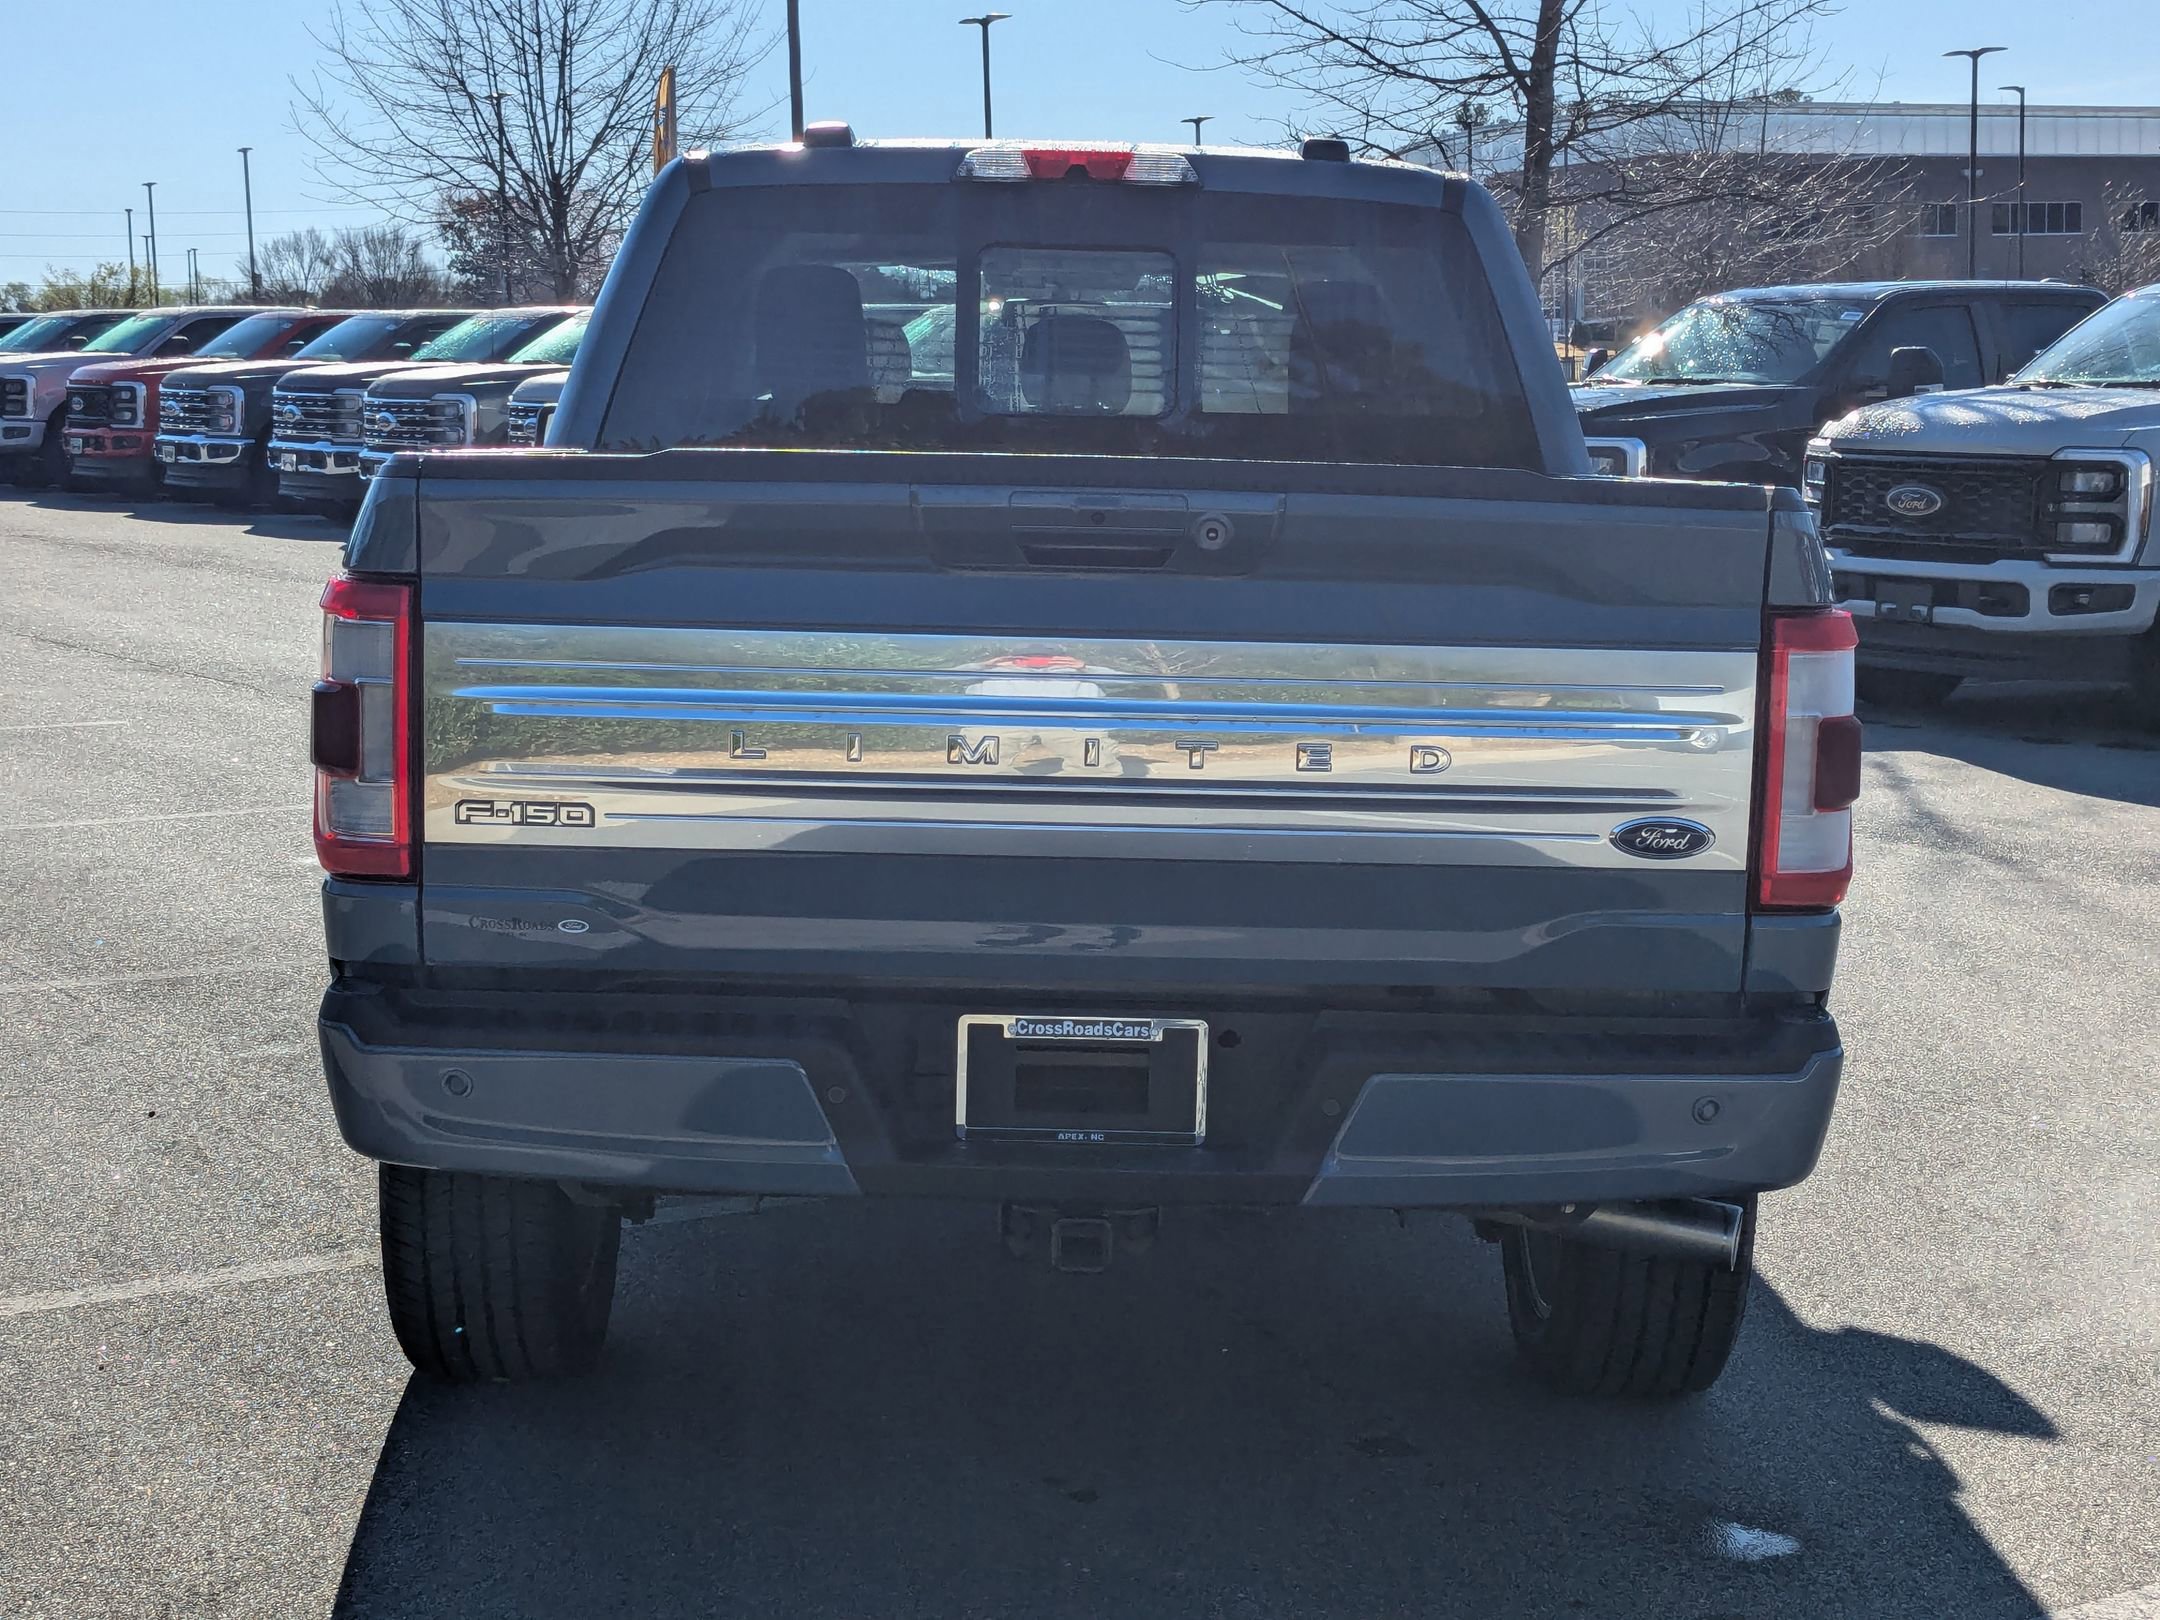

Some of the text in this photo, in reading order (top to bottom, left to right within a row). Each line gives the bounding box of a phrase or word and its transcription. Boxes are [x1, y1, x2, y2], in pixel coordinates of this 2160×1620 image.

[1897, 492, 1928, 509] Ford
[729, 729, 1452, 775] LIMITED
[455, 799, 595, 828] F-150
[1635, 827, 1691, 850] Ford
[1016, 1020, 1150, 1037] CrossRoadsCars
[1090, 1133, 1105, 1141] NC
